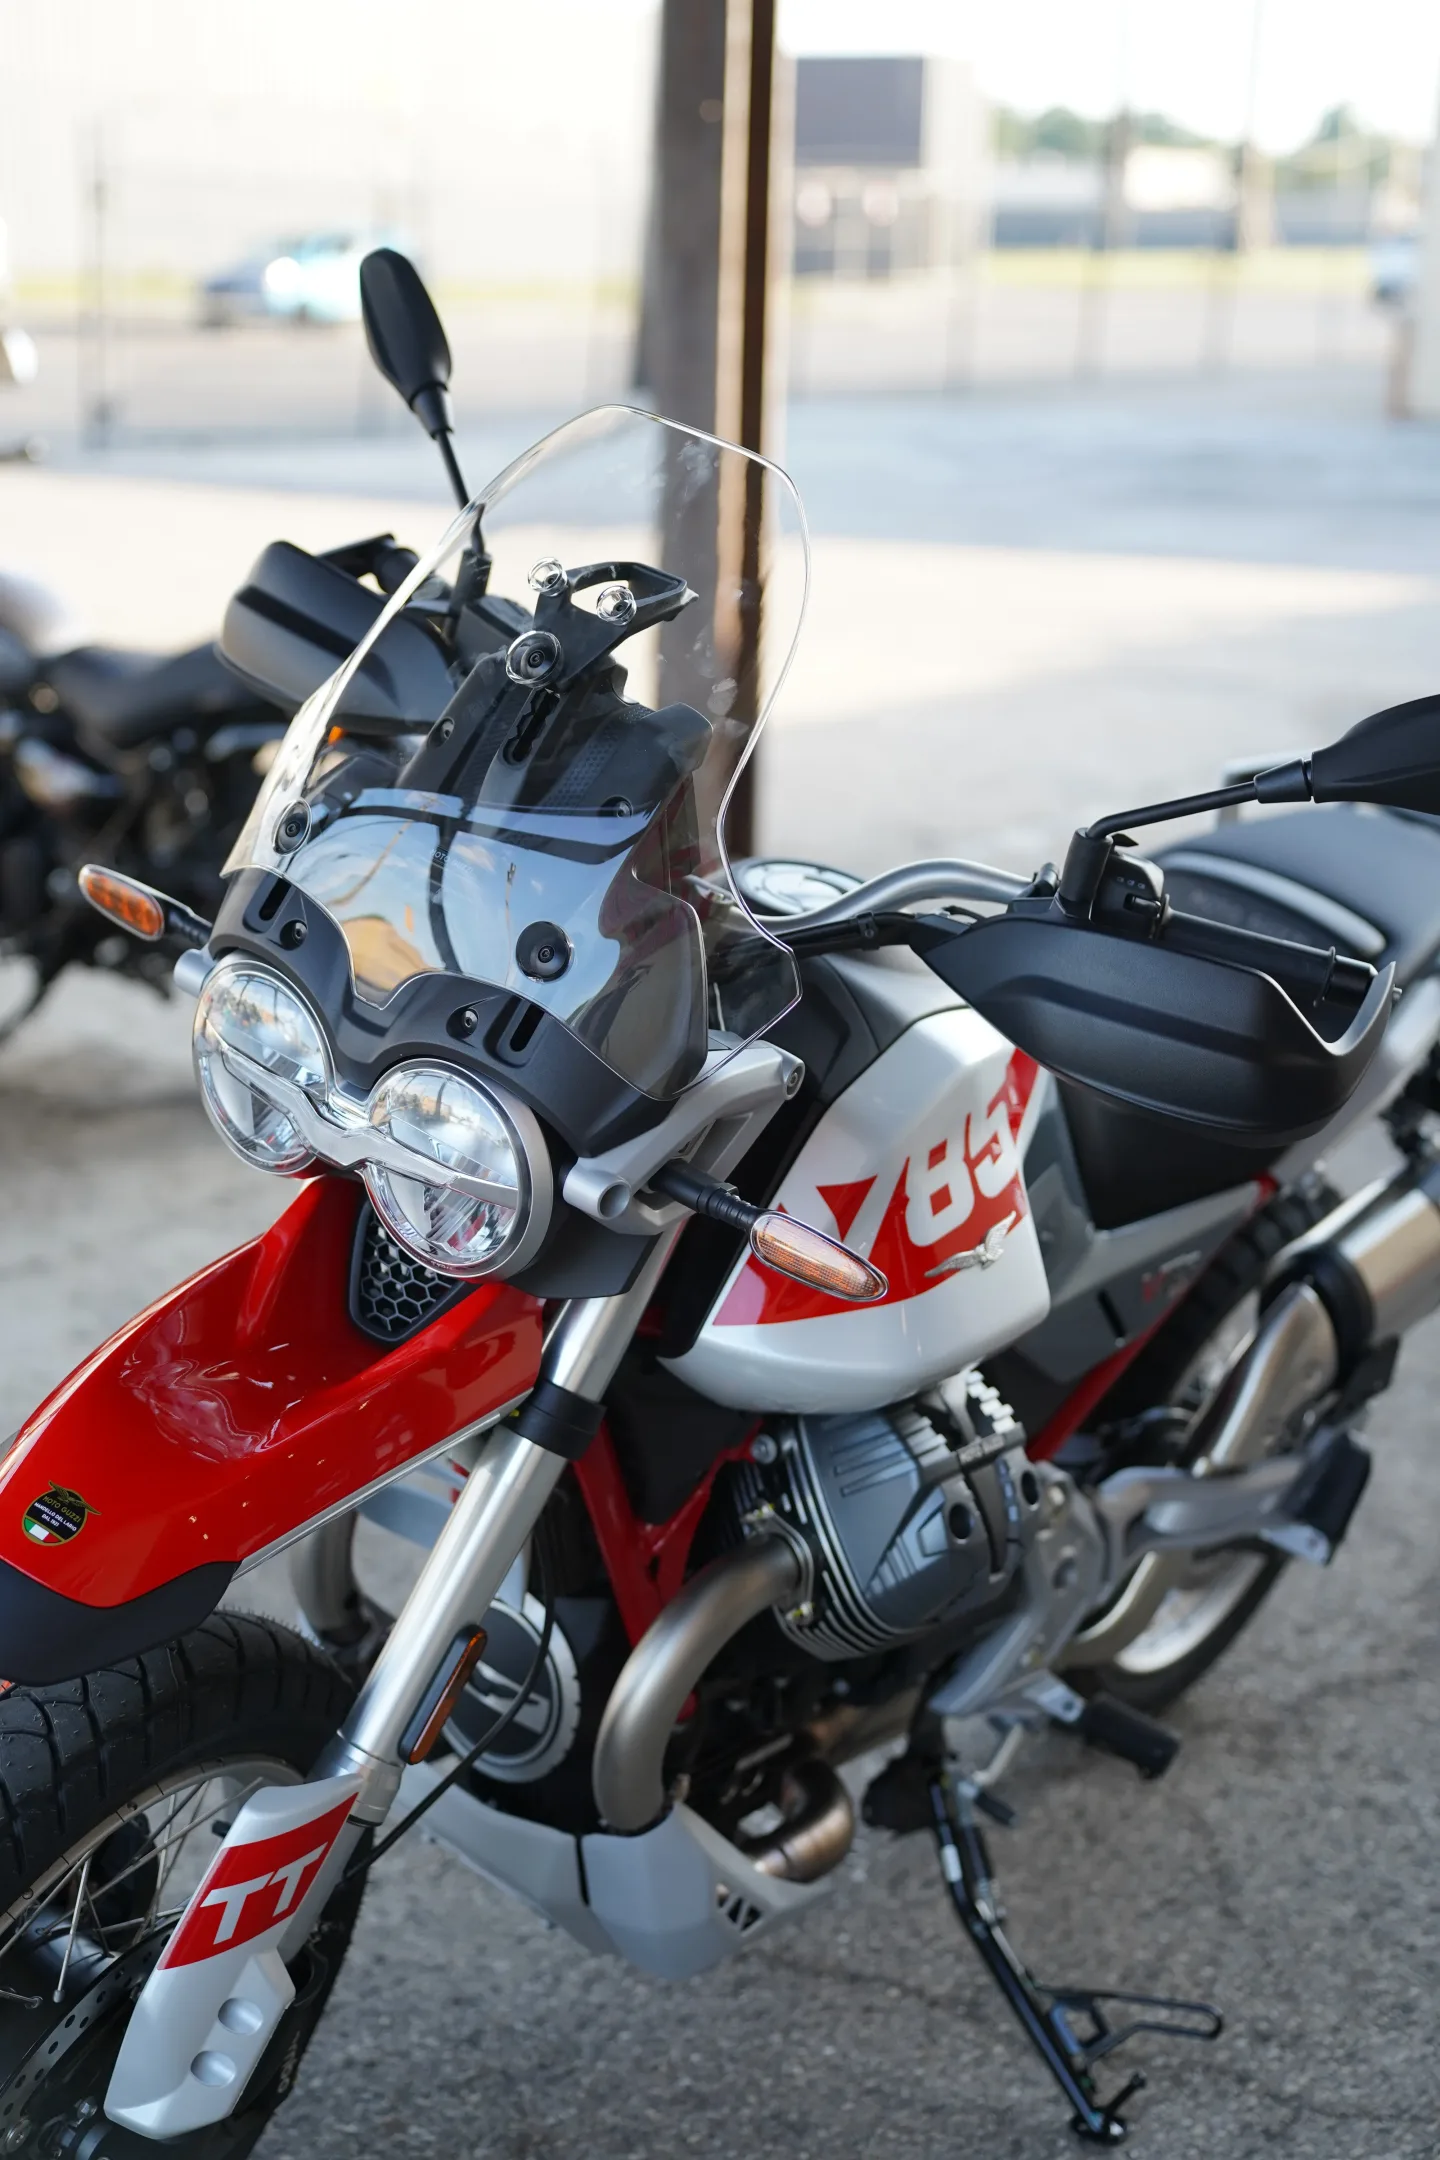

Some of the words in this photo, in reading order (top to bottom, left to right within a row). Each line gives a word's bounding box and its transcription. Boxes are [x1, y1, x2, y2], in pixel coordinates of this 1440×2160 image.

[778, 1100, 1019, 1260] V85
[34, 1502, 56, 1516] MANDELLO
[55, 1514, 64, 1522] DEL
[63, 1520, 77, 1531] LARIO
[41, 1514, 51, 1522] DAL
[43, 1496, 60, 1508] MOTO
[61, 1507, 81, 1522] GUZZI
[200, 1841, 328, 1945] TT
